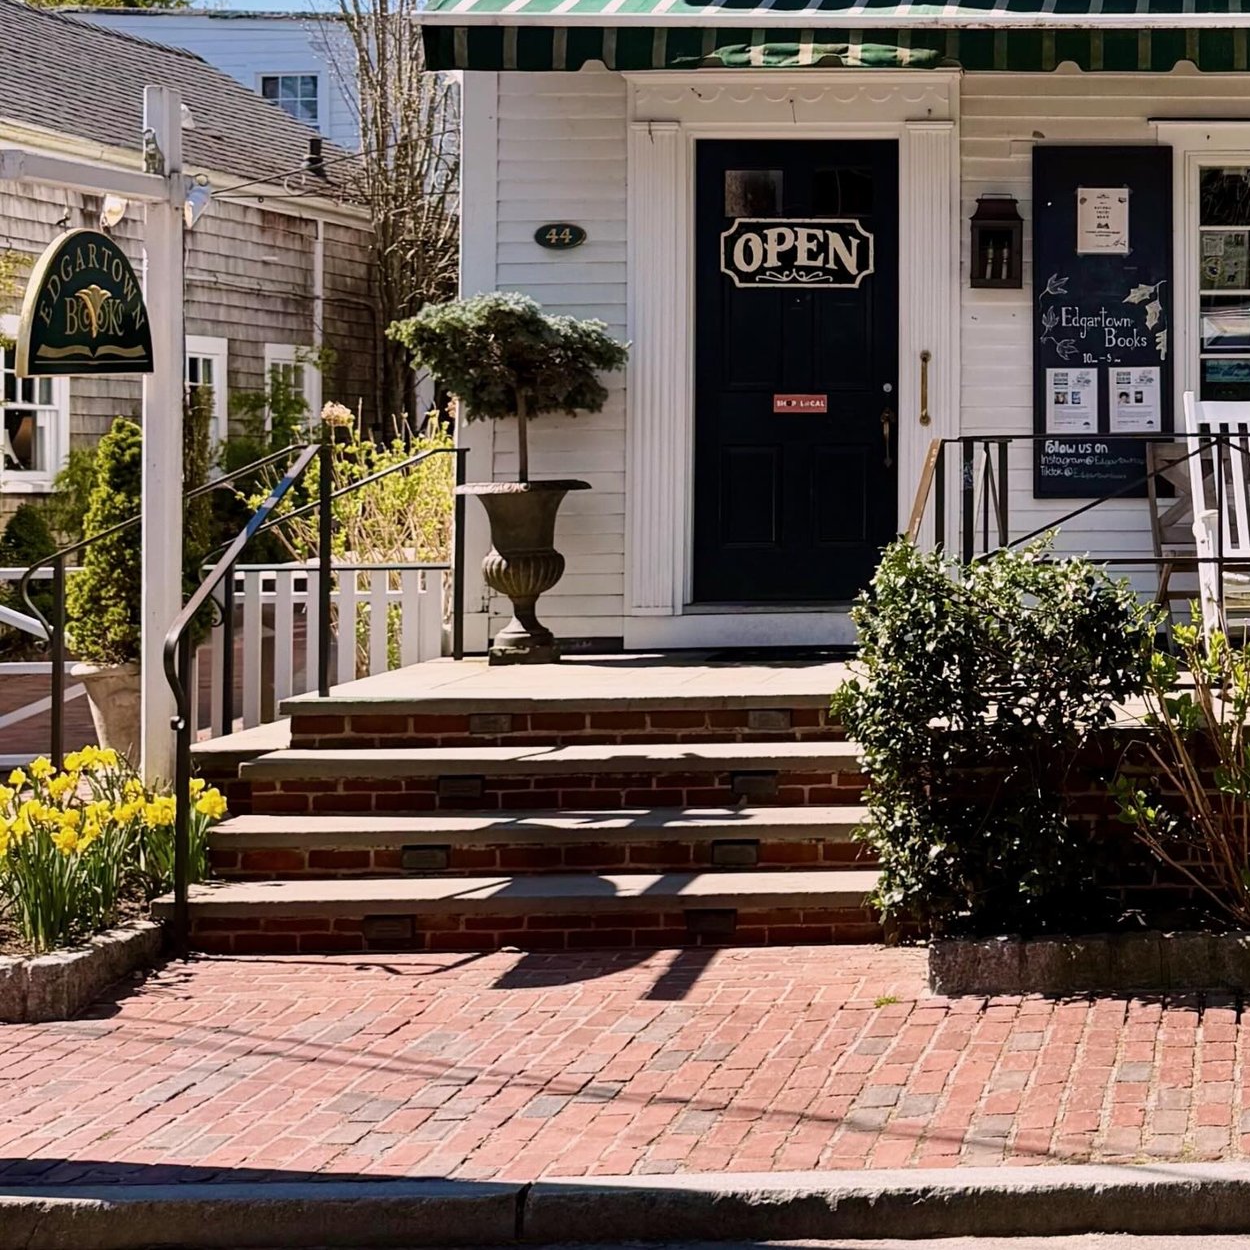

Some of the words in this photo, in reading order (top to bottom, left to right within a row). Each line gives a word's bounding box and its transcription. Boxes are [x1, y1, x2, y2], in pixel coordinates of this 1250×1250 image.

[545, 228, 573, 244] 44
[733, 227, 860, 275] OPEN
[39, 242, 145, 330] EDGARTOWN
[65, 296, 125, 337] BOOKS
[1061, 306, 1132, 339] Edgartown
[1104, 327, 1148, 348] Books
[1078, 443, 1092, 453] us
[1094, 443, 1109, 453] on
